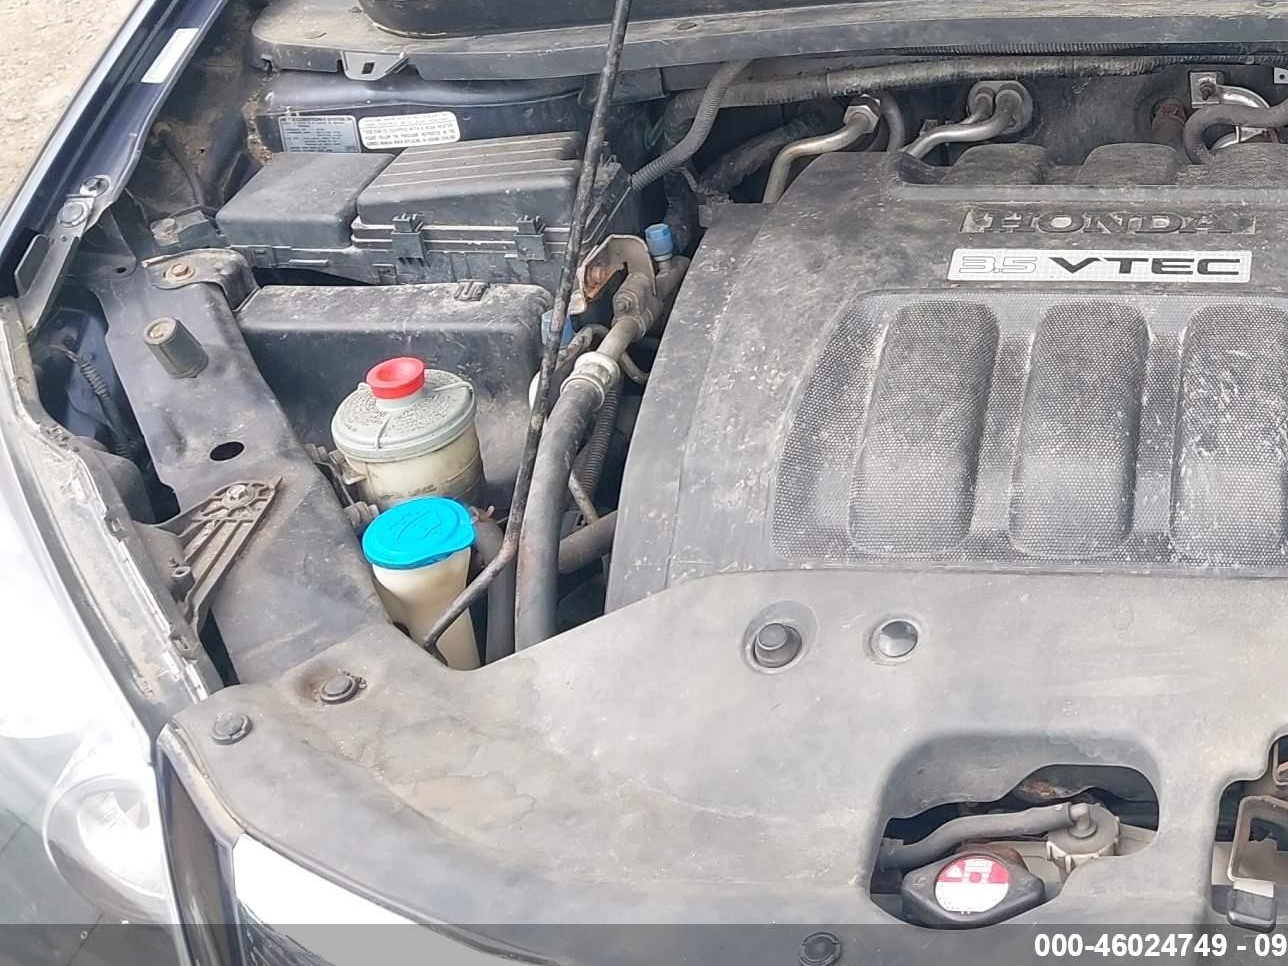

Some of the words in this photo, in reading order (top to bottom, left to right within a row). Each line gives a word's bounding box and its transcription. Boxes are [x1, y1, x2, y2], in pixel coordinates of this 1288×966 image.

[985, 210, 1233, 233] HONDA
[958, 255, 1038, 274] 3.5
[1047, 257, 1241, 275] VTEC
